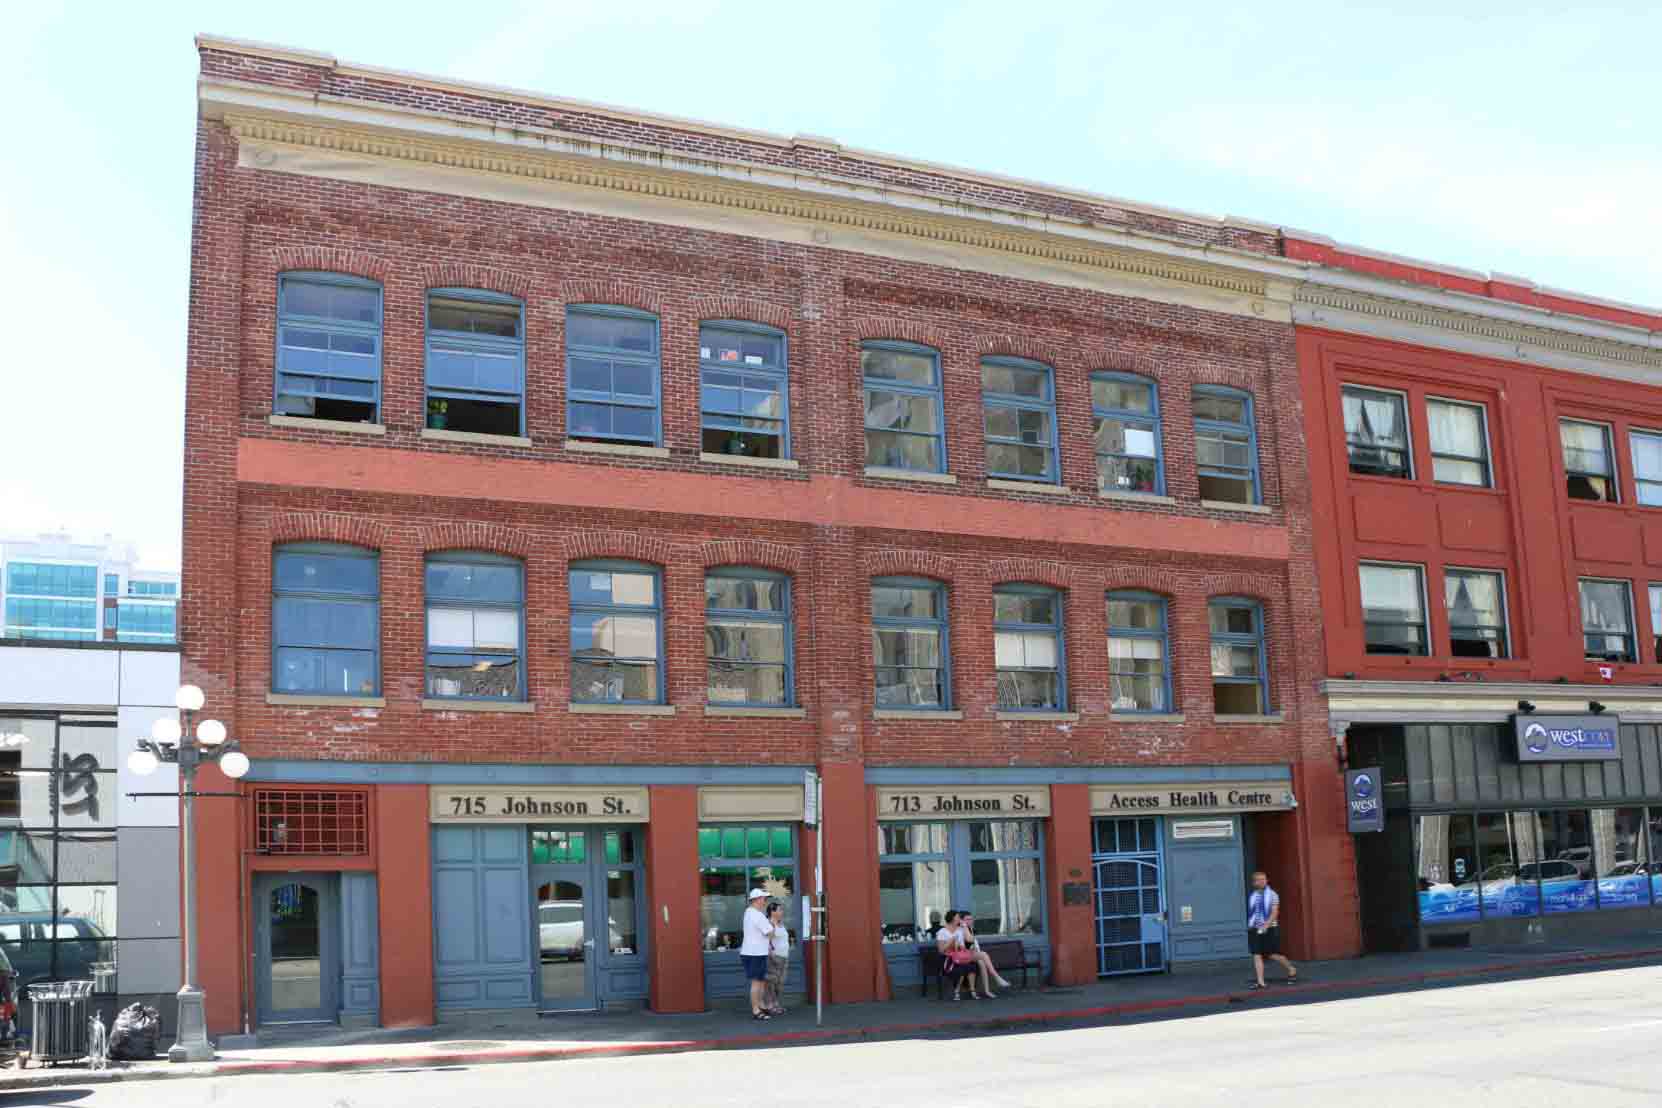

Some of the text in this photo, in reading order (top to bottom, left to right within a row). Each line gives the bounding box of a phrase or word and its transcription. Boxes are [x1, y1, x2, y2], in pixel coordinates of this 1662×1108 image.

[449, 796, 631, 815] 715 Johnson St.
[890, 794, 1036, 812] 713 Johnson St.
[1109, 790, 1273, 809] Access Health Centre
